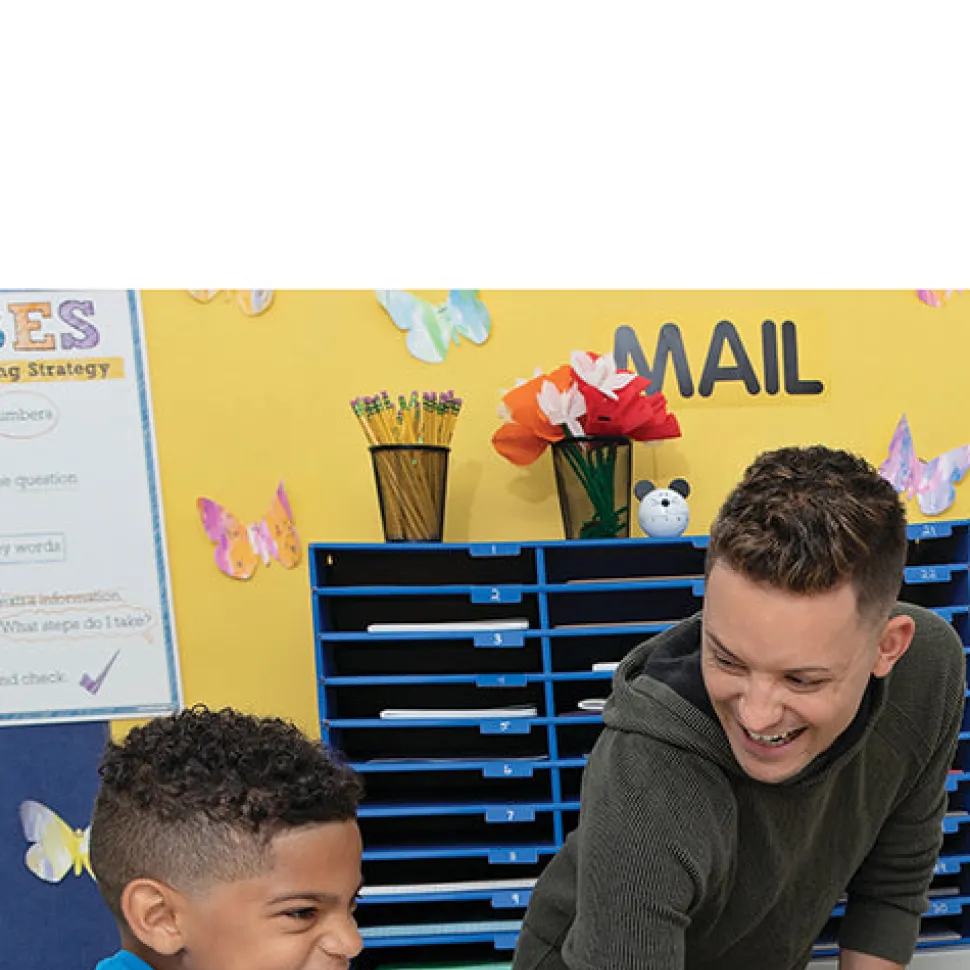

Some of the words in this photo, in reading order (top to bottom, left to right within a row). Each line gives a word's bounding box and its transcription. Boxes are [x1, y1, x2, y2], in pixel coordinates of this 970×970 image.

[0, 300, 100, 351] ES
[28, 361, 110, 379] Strategy
[614, 319, 824, 397] MAIL
[491, 588, 500, 600] 2
